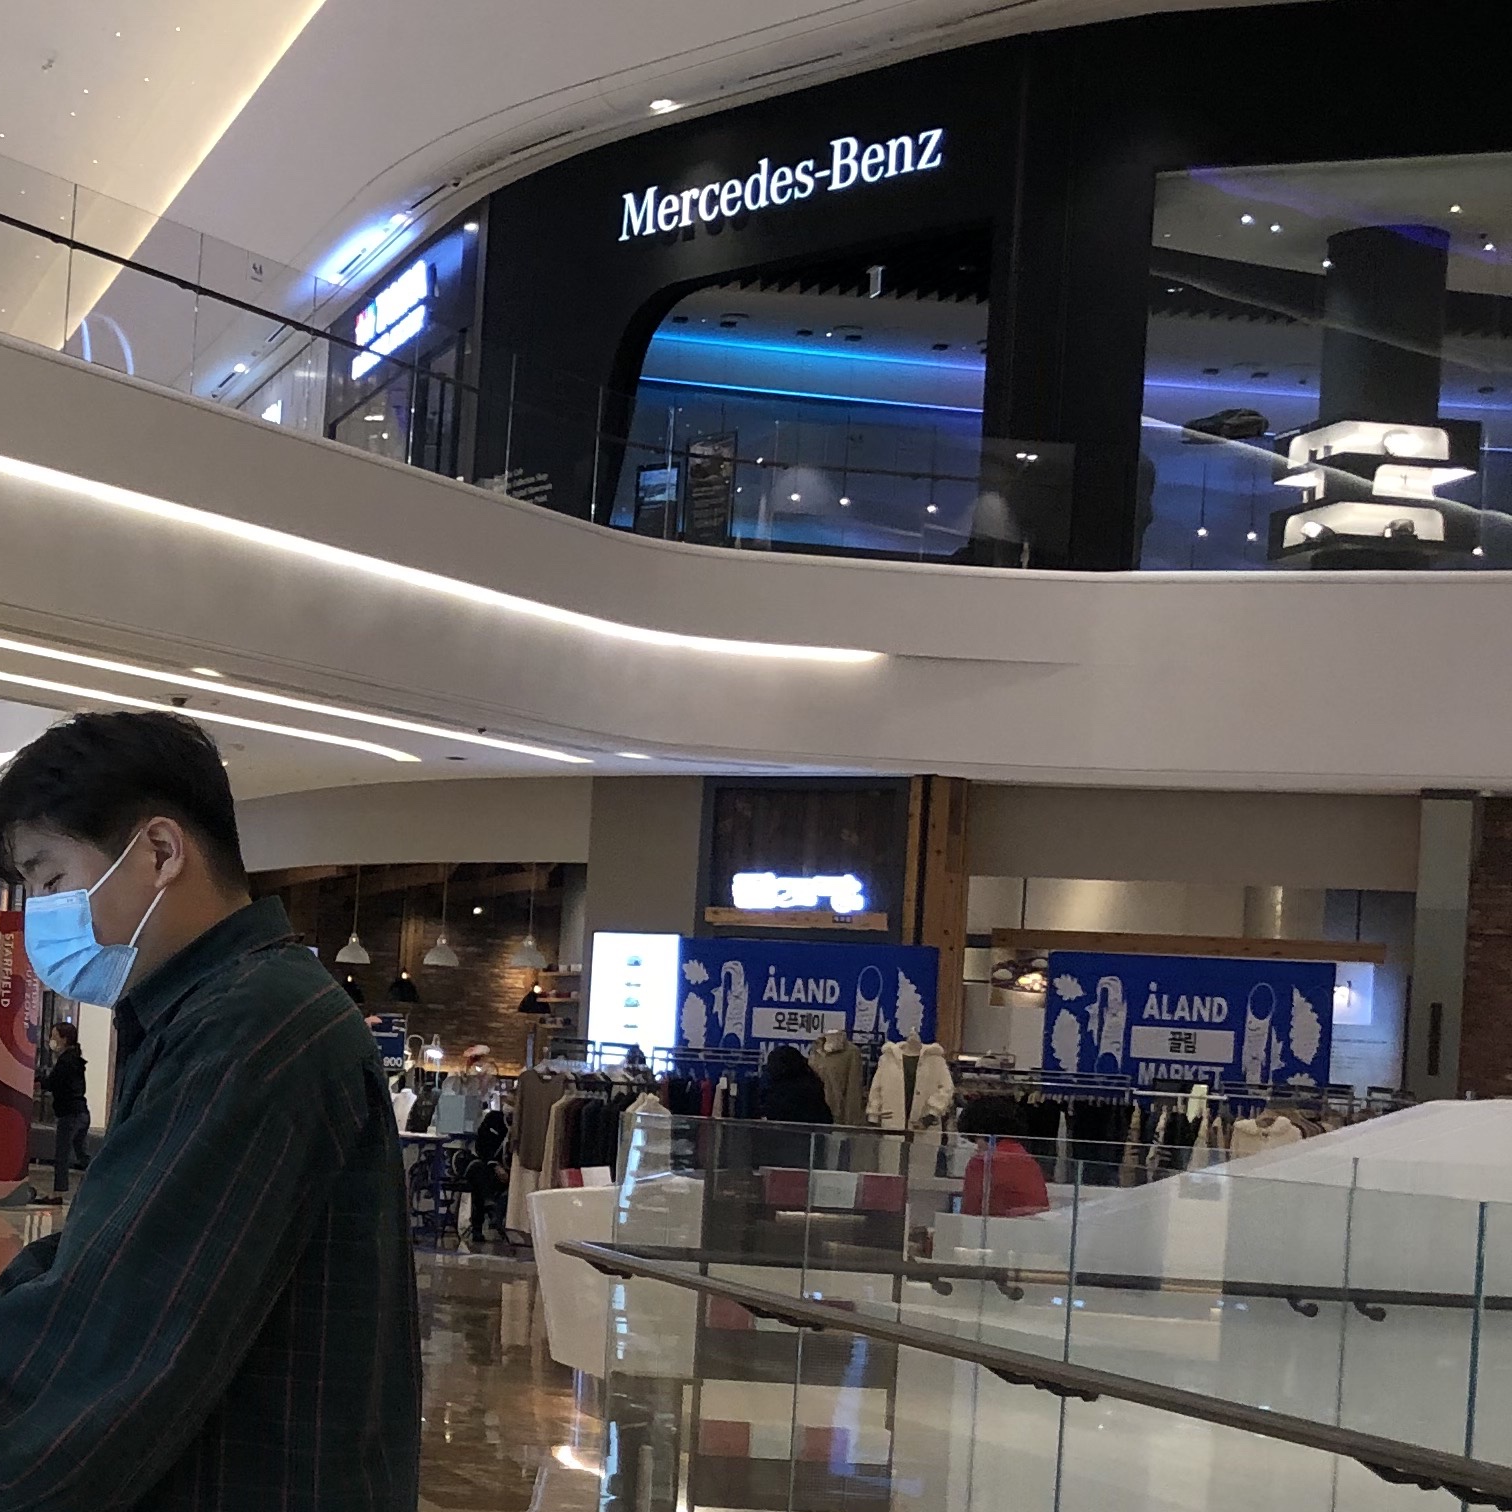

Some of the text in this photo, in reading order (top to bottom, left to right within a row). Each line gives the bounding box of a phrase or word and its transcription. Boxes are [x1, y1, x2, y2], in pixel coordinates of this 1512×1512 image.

[618, 128, 943, 242] Mercedes-Benz
[1, 933, 14, 1008] STARFIELD
[762, 965, 840, 1004] ÅLAND
[1142, 981, 1228, 1023] ÅLAND
[1139, 1061, 1225, 1090] MARKET
